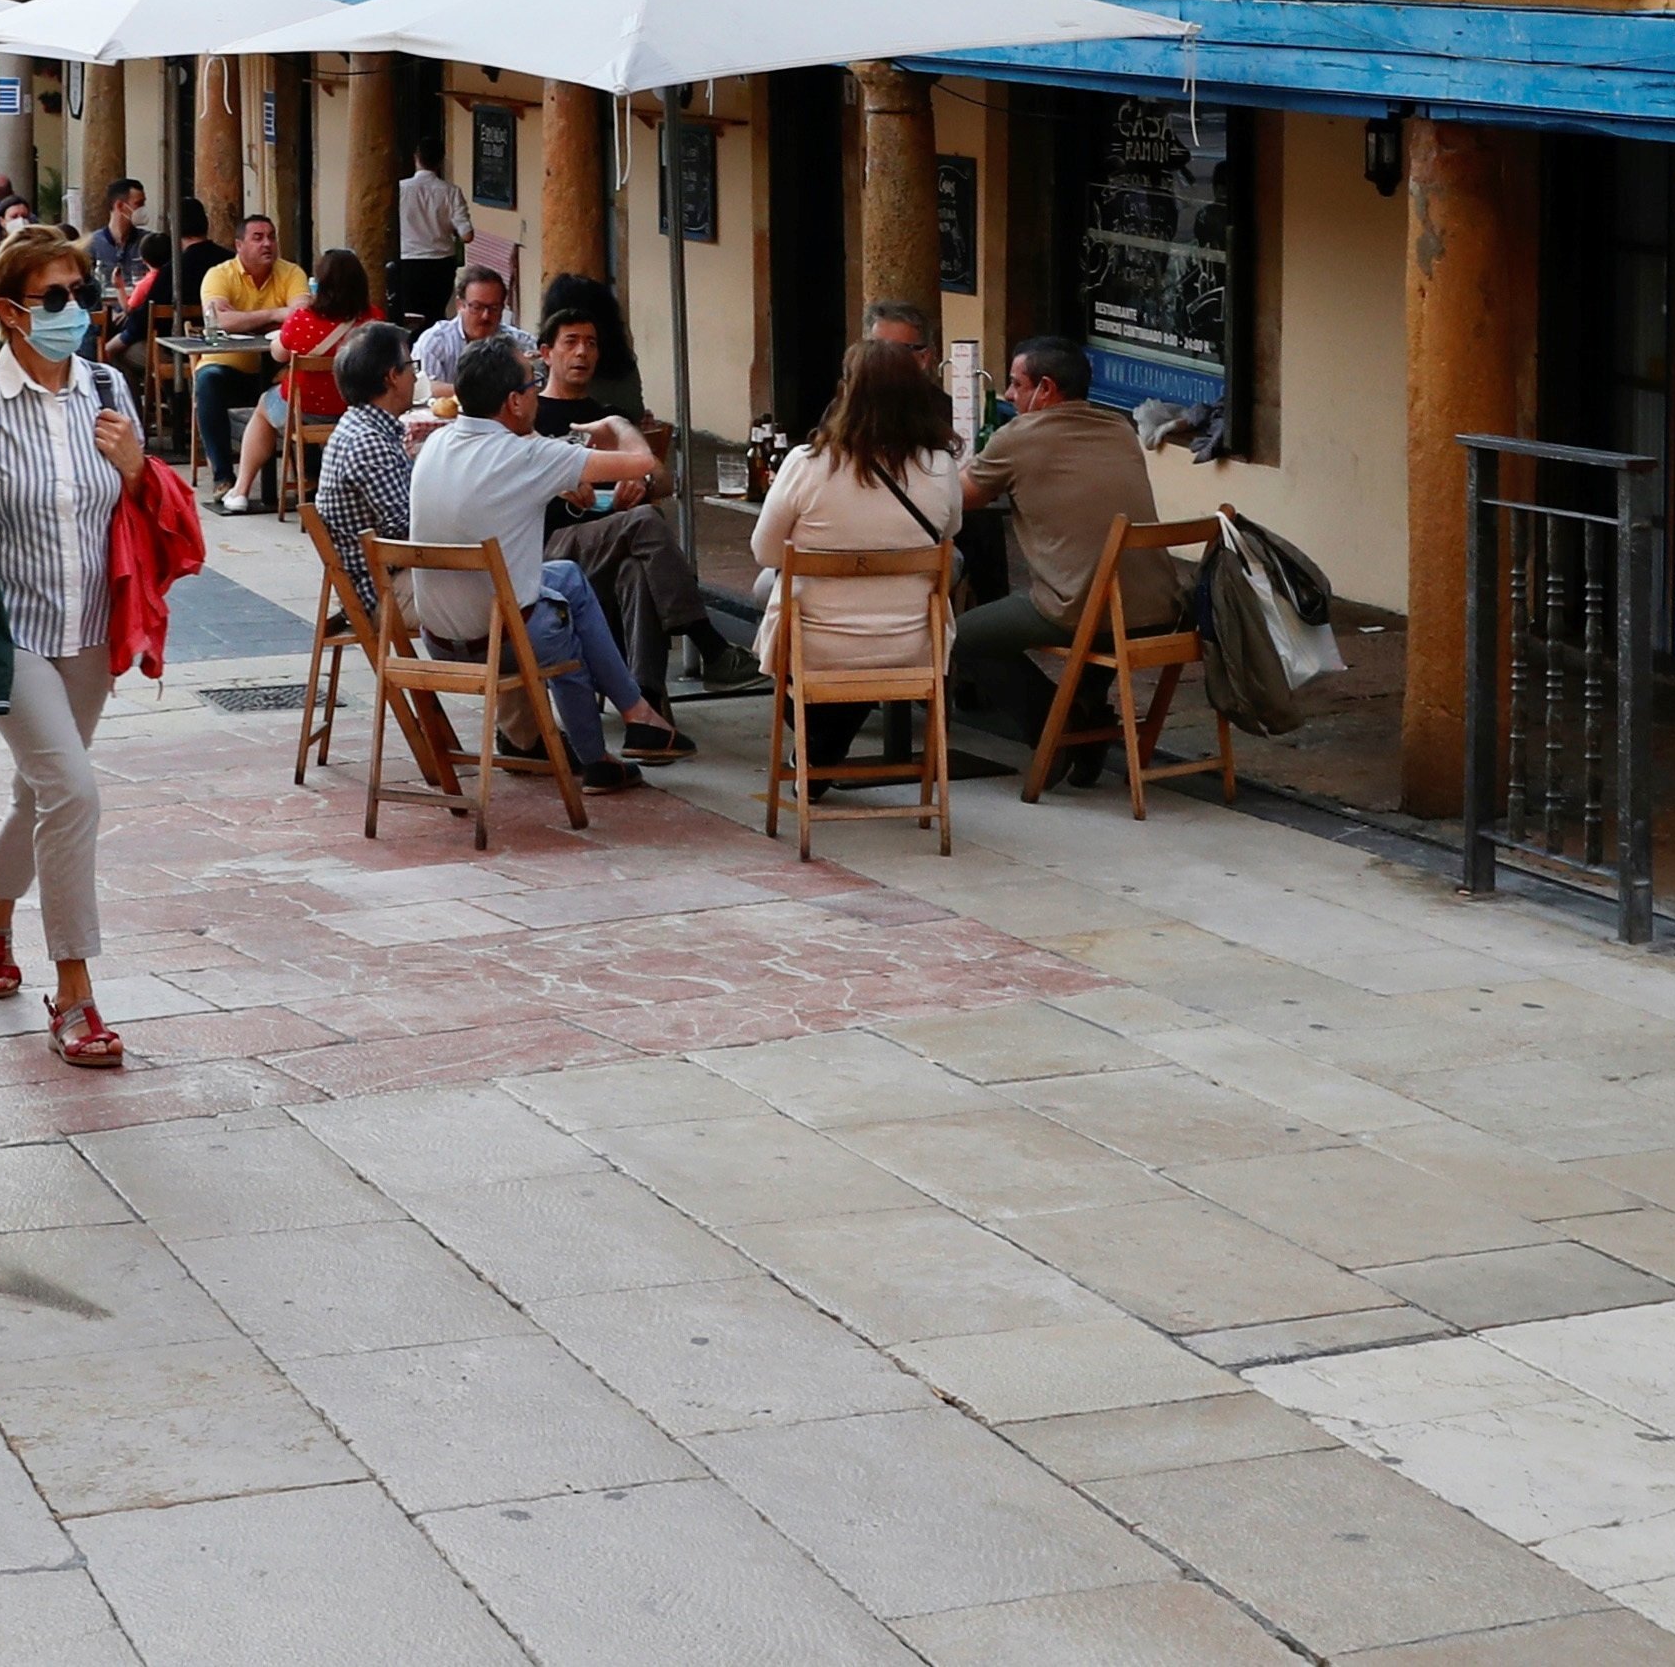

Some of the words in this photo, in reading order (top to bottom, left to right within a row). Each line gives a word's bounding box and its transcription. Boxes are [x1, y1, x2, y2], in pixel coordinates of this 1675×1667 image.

[1117, 99, 1176, 141] CASA
[1125, 141, 1170, 163] RAMON
[1094, 300, 1138, 322] RESTAURANTE
[855, 556, 869, 571] R
